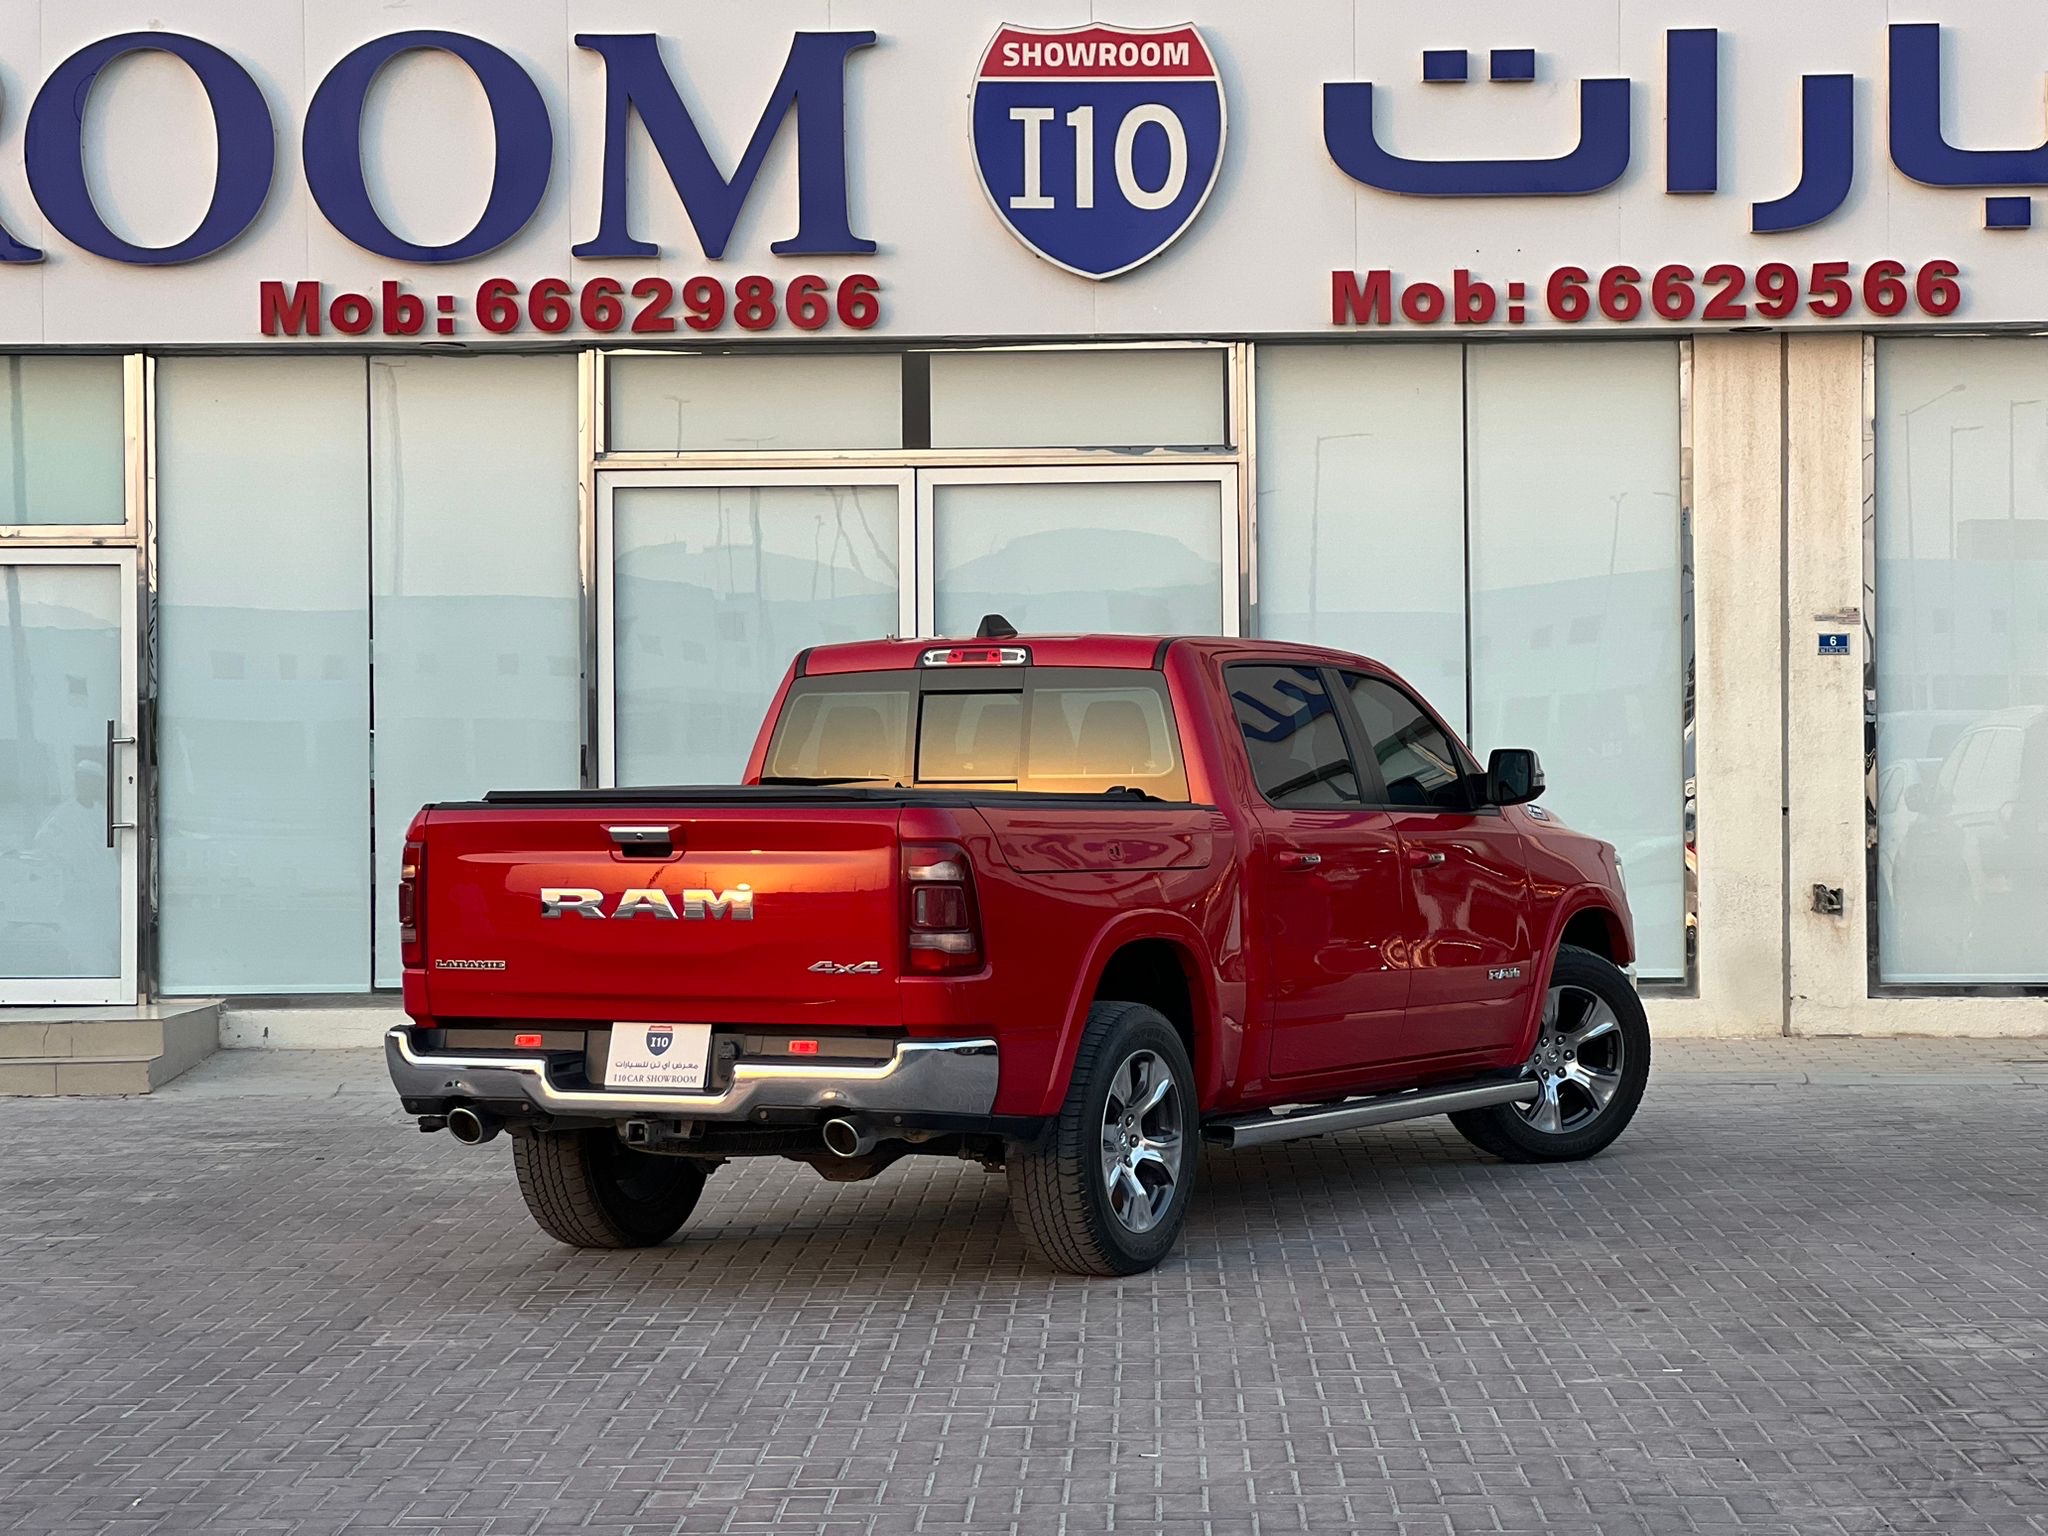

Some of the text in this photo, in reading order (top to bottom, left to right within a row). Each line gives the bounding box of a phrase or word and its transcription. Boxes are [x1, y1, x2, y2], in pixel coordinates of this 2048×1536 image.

[1002, 42, 1189, 67] SHOWROOM
[0, 29, 879, 264] OOM
[1009, 103, 1188, 210] I10
[1830, 636, 1837, 646] 6
[541, 887, 754, 920] RAM
[435, 959, 506, 970] LARAMIE
[651, 1037, 669, 1047] I10
[646, 1074, 697, 1084] SHOWROOM
